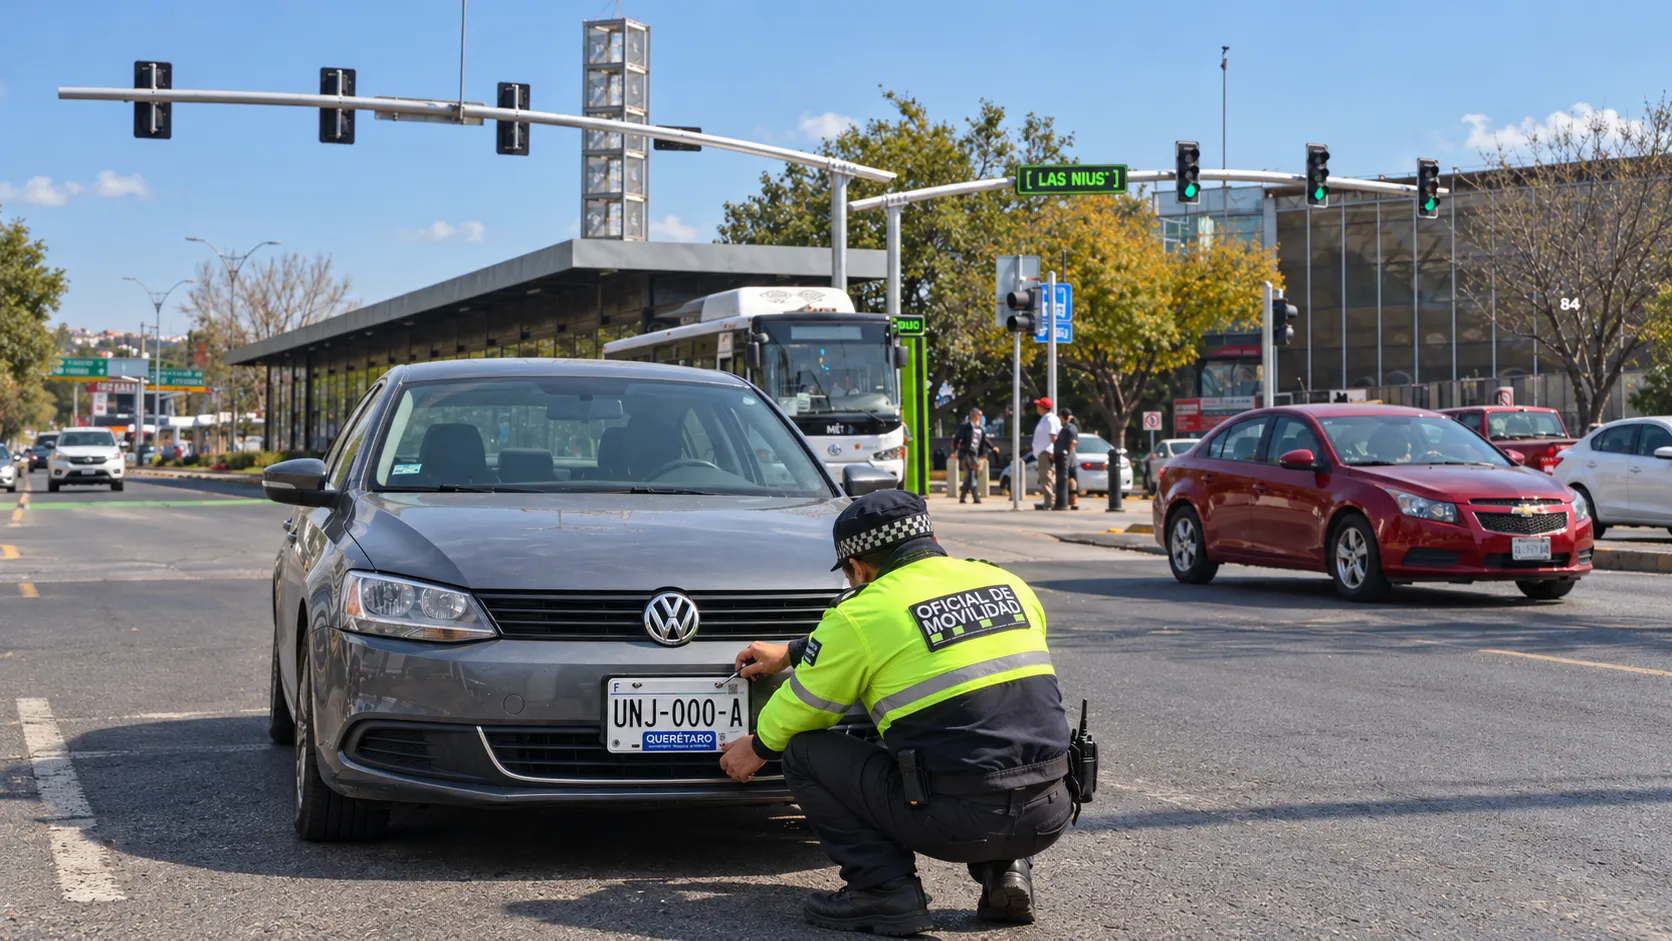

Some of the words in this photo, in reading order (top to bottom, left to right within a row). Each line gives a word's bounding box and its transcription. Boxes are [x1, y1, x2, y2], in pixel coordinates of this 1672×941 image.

[1038, 172, 1067, 186] LAS
[916, 591, 990, 619] OFICIAL
[988, 587, 1015, 601] DE
[922, 600, 1021, 635] MOVILIDAD
[613, 682, 620, 692] F
[613, 698, 743, 728] UNJ-000-A
[646, 732, 713, 744] QUERÉTARO
